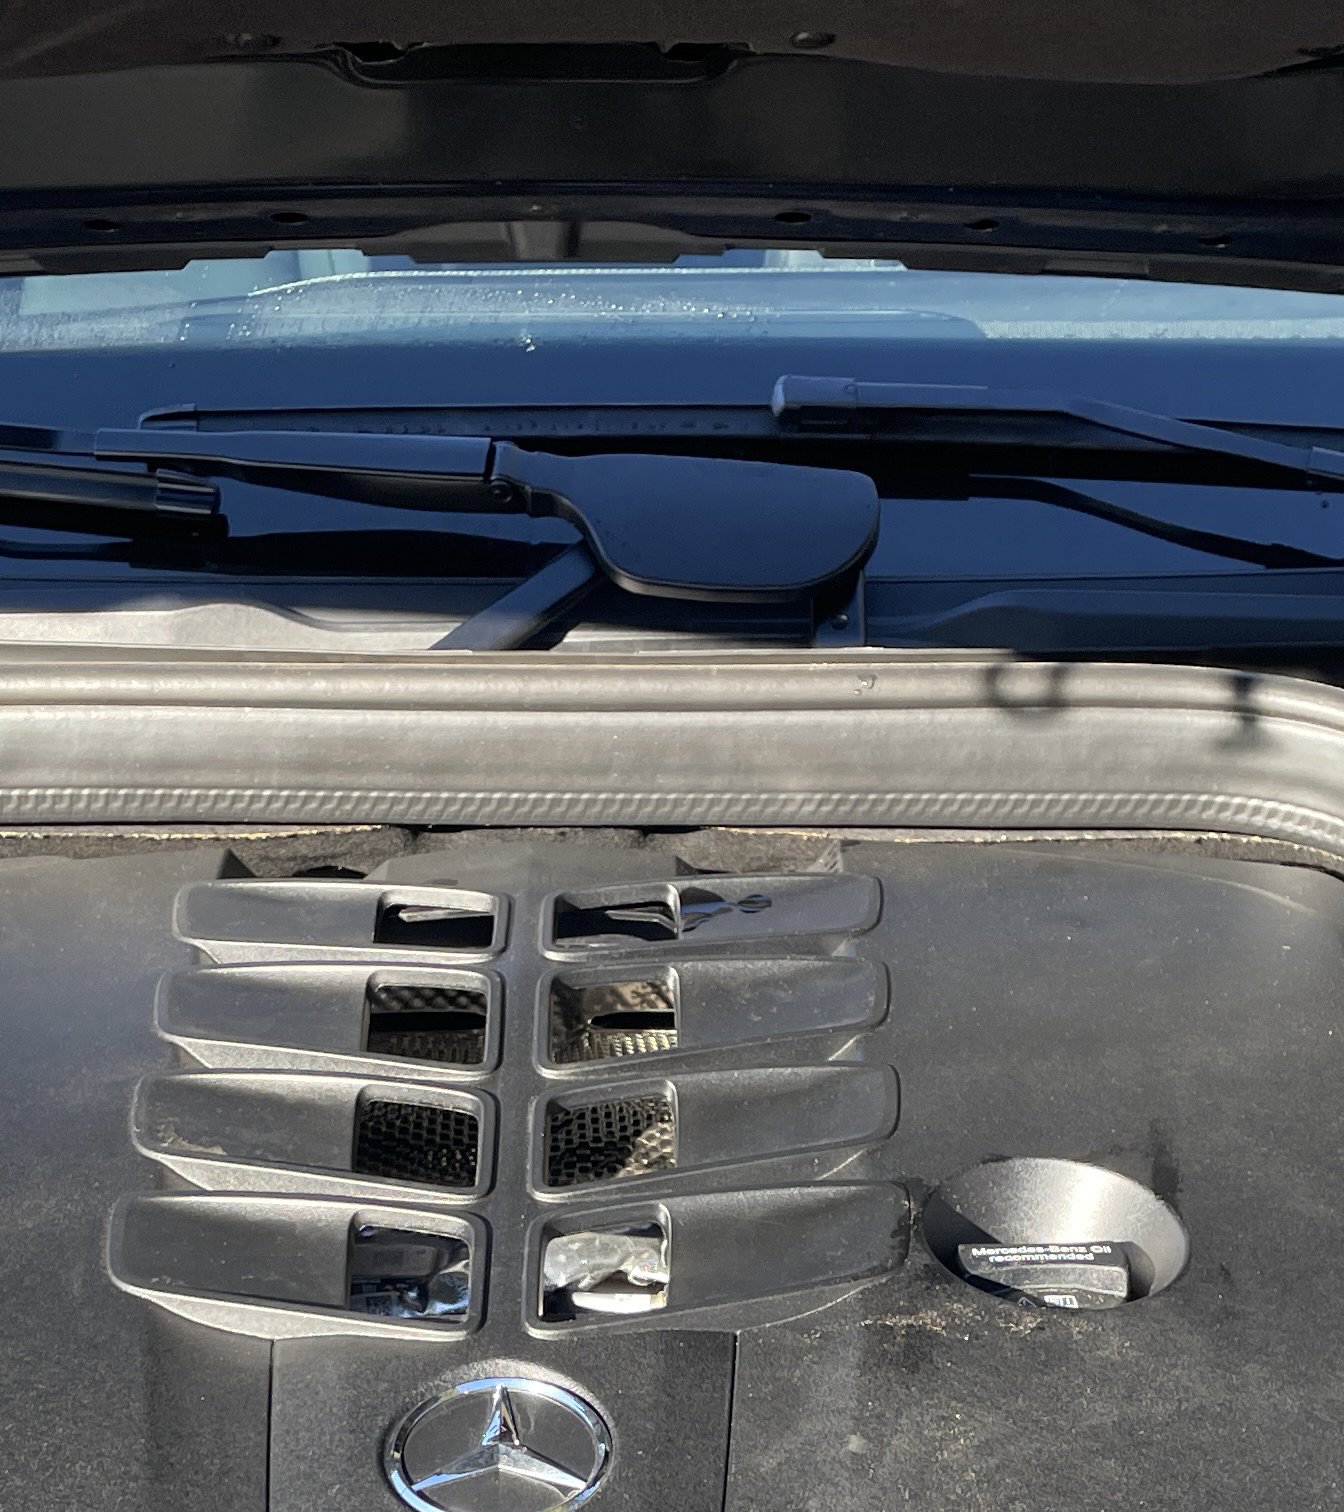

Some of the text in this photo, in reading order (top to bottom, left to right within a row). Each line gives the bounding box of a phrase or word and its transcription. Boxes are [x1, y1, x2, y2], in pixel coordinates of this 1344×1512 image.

[971, 1244, 1113, 1256] Mercedes-Benz Oil
[990, 1253, 1095, 1262] recommended
